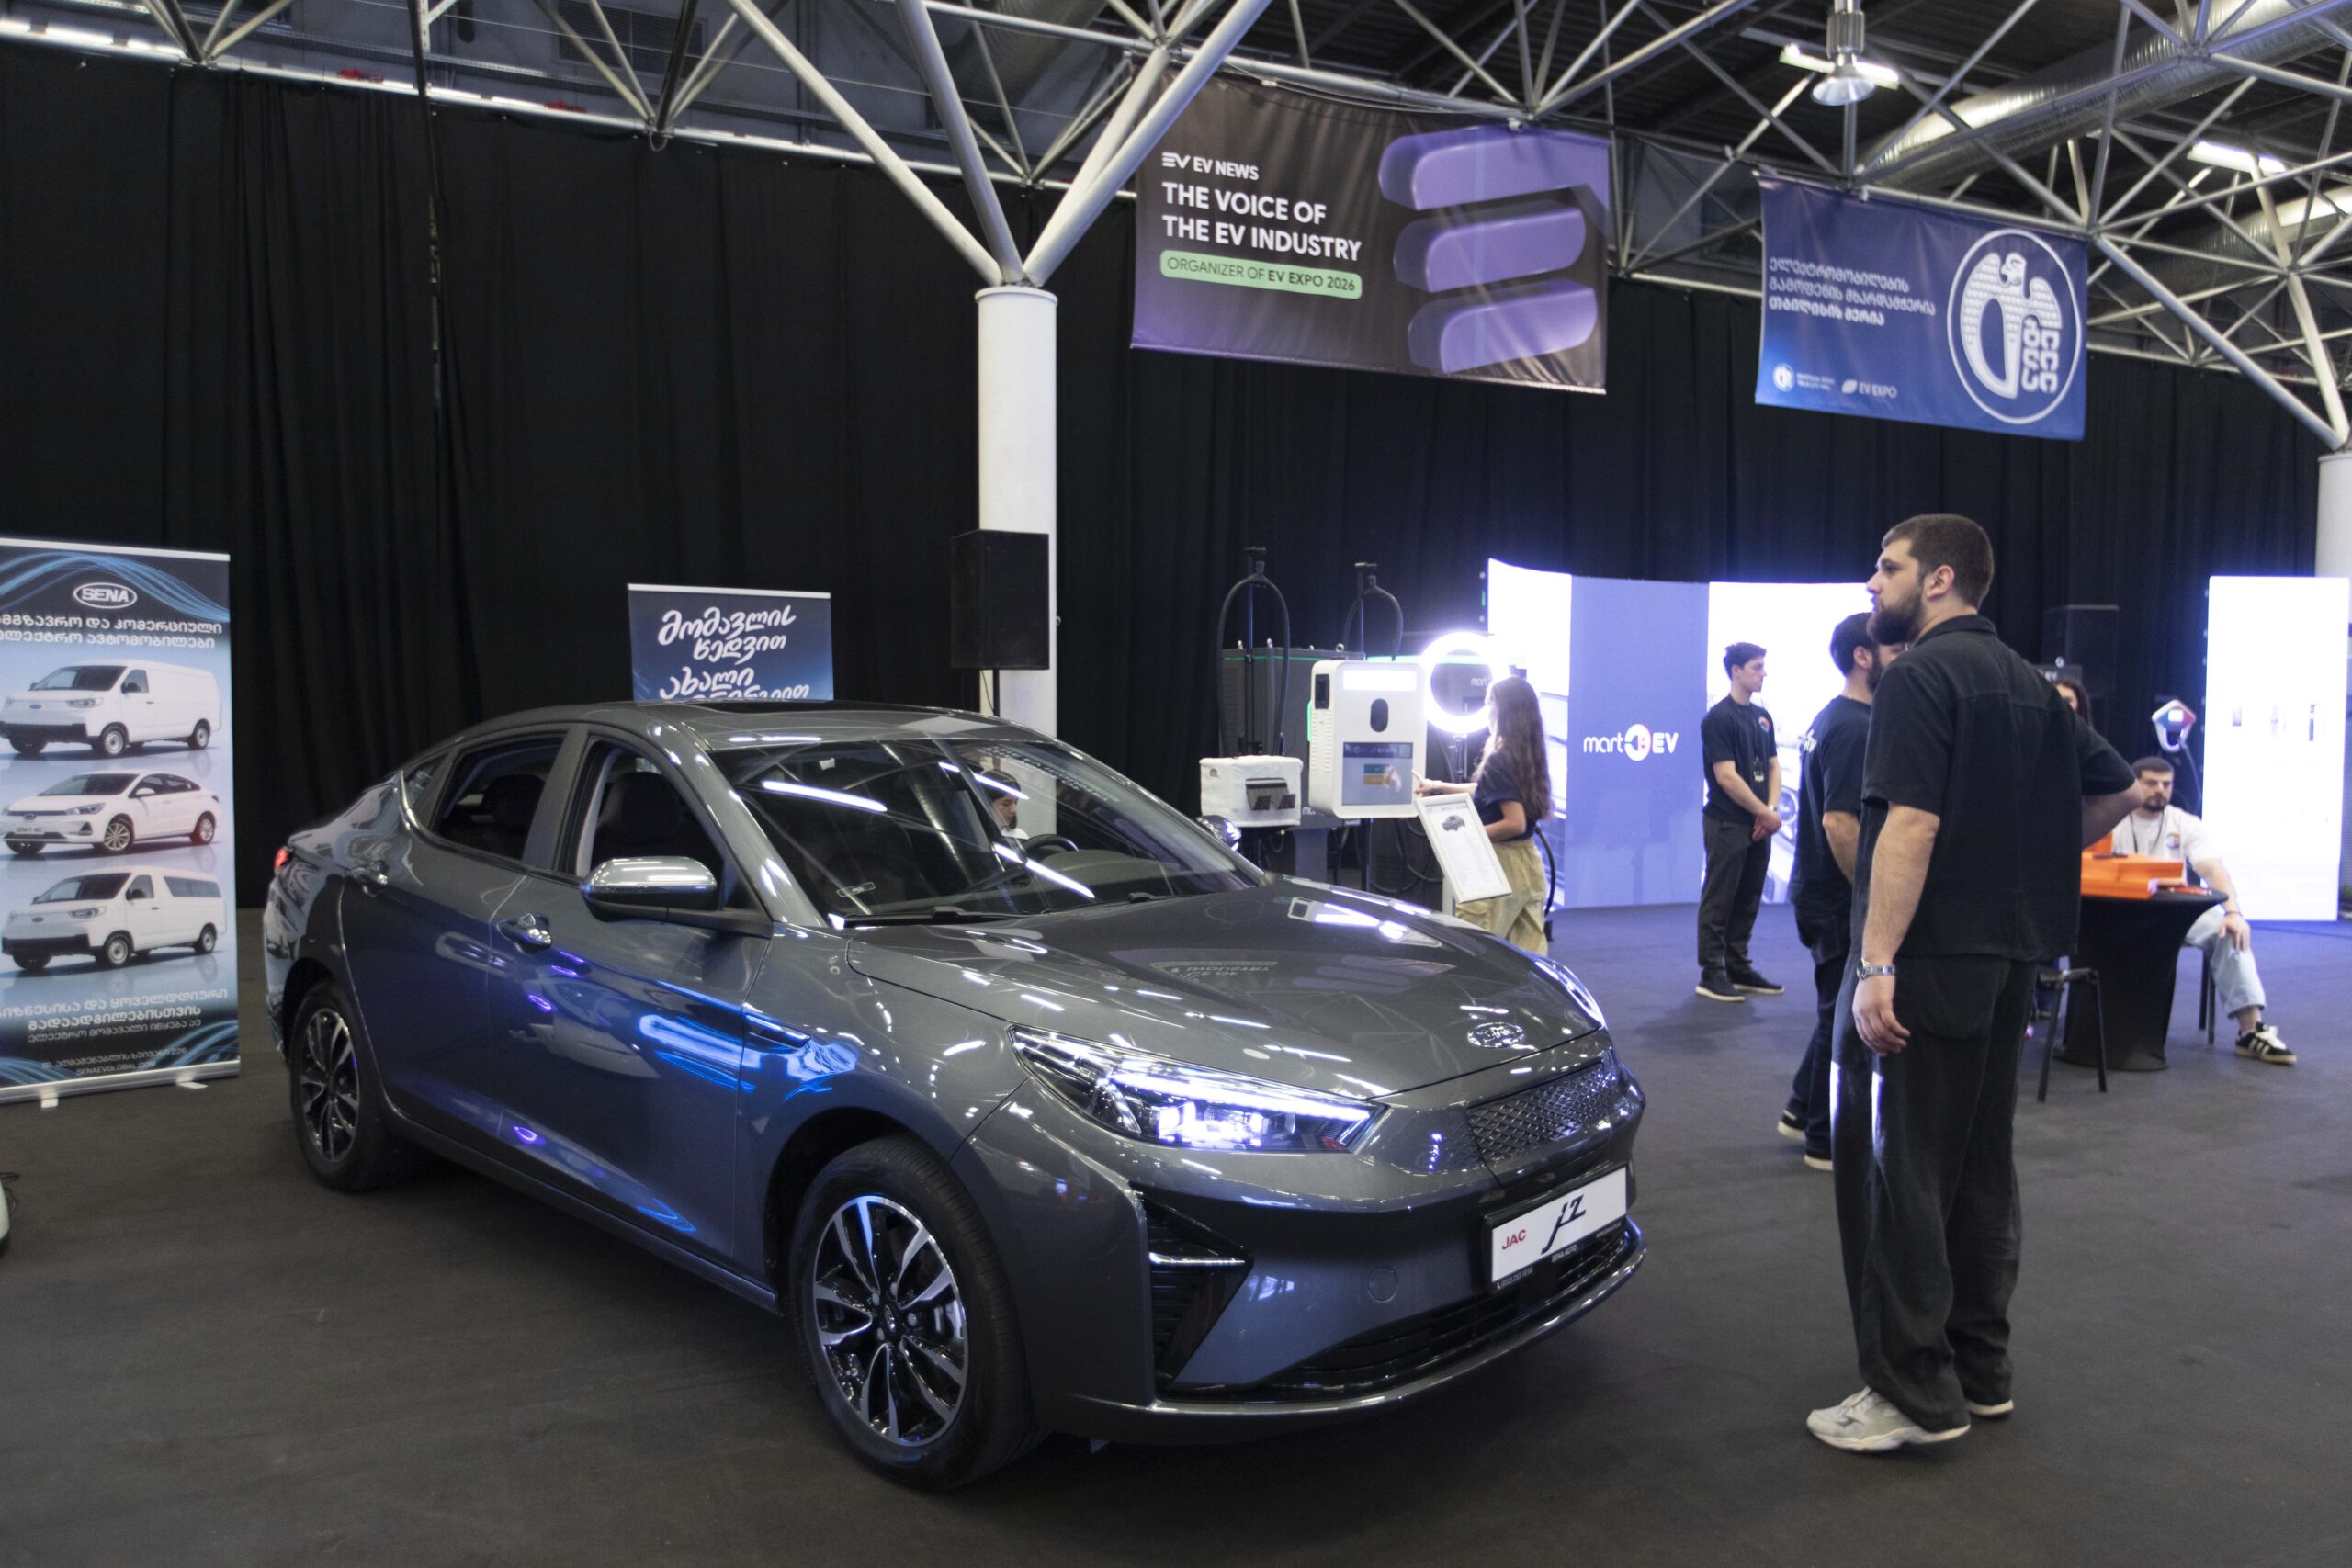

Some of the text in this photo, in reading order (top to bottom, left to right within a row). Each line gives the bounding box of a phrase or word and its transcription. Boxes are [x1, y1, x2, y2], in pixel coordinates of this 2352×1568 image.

[1193, 156, 1213, 174] EV
[1215, 161, 1259, 181] NEWS
[1162, 182, 1327, 225] THE VOICE OF
[1162, 215, 1362, 261] THE EV INDUSTRY
[1167, 257, 1355, 291] ORGANIZER OF EV EXPO 2026
[1871, 383, 1897, 399] EXPO
[82, 588, 130, 603] SENA
[0, 615, 222, 634] მგზავრო და კომერციული
[658, 604, 797, 646] მომავლის
[87, 634, 216, 649] ავტომობილები
[693, 635, 786, 665] ხედვით
[660, 666, 755, 699] ახალი
[1583, 732, 1679, 753] mart EV
[84, 999, 107, 1010] და
[28, 1006, 201, 1031] გადაადგილებისთვის
[1502, 1229, 1527, 1250] JAC
